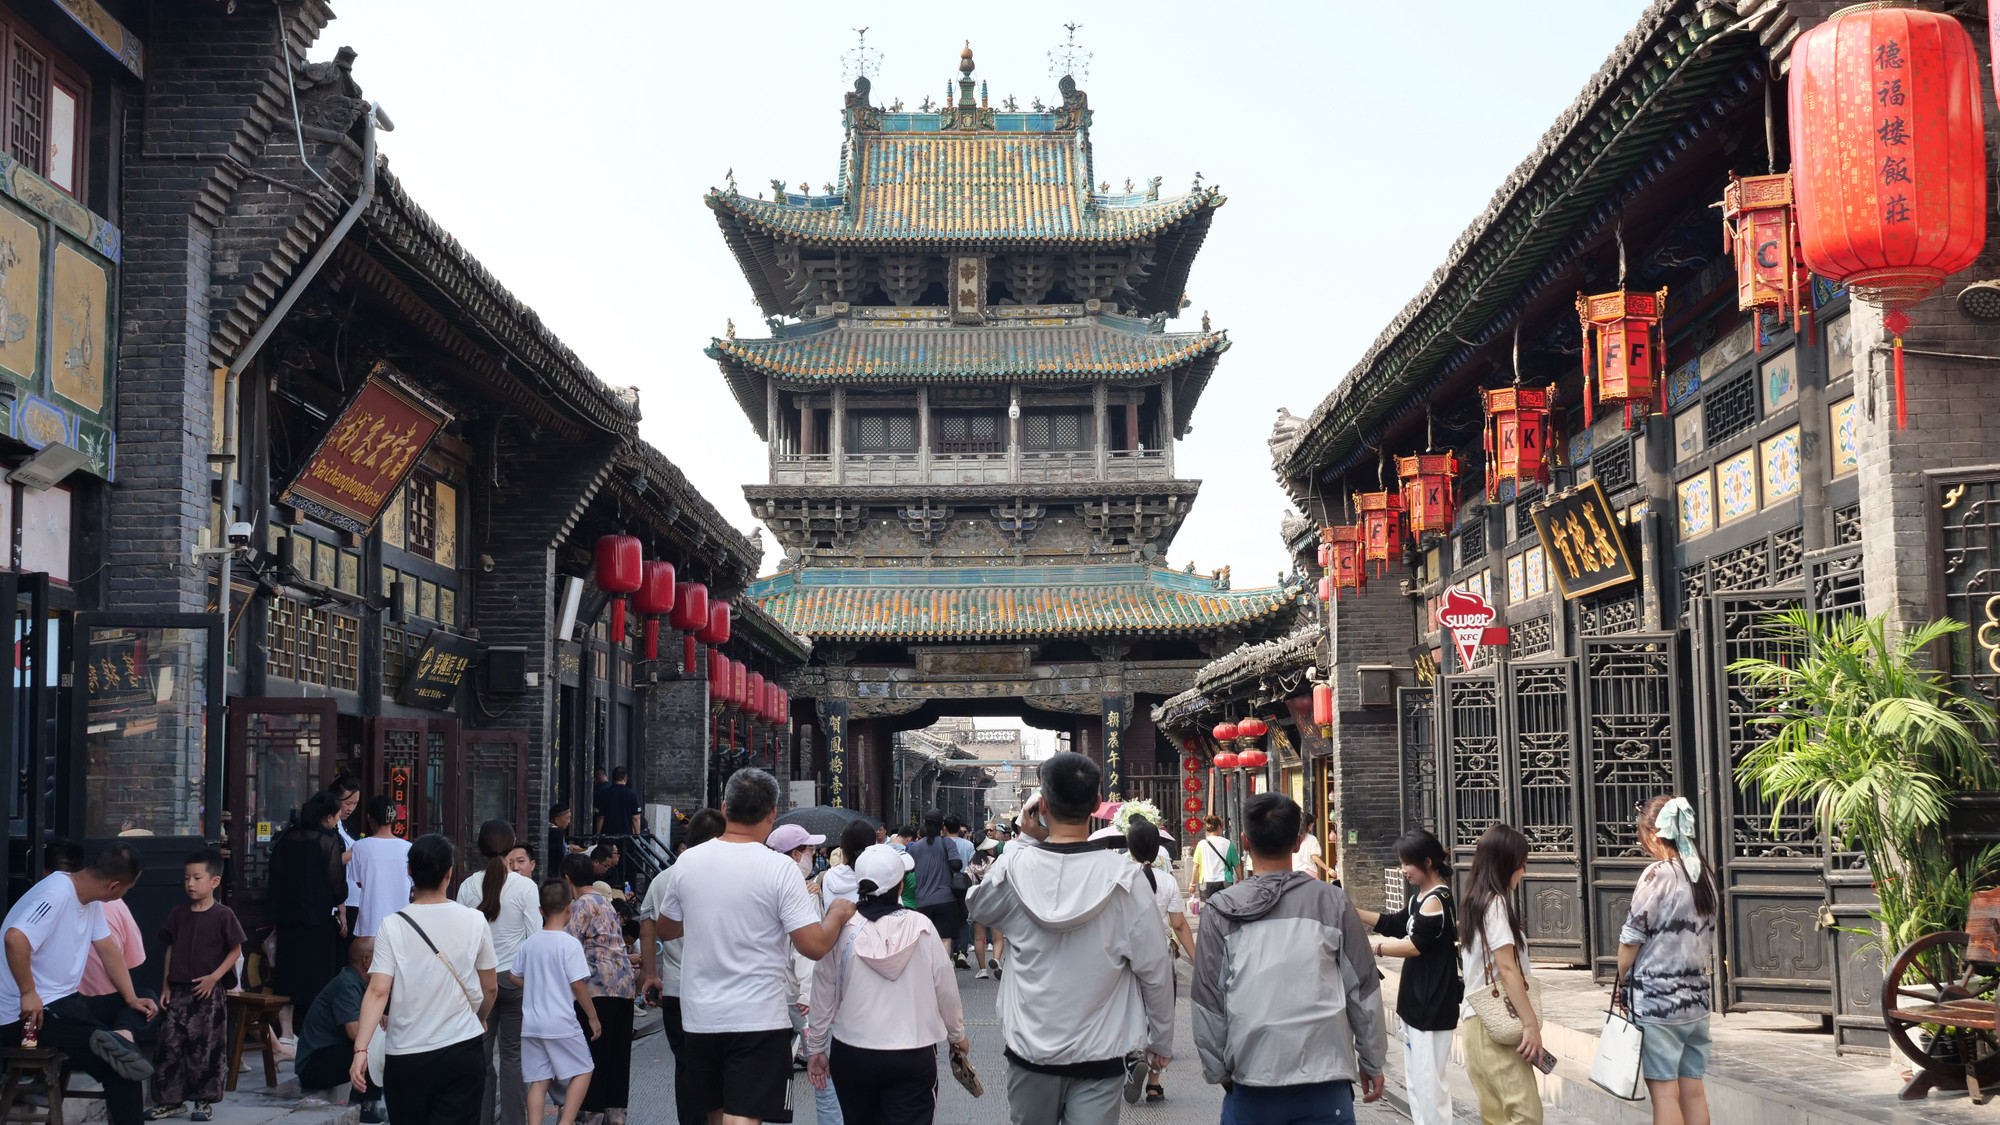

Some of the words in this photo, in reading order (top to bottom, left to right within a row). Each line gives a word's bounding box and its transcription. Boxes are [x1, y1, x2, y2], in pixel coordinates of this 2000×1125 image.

[1757, 240, 1779, 269] C
[1606, 343, 1621, 368] F
[1630, 343, 1645, 366] F
[1504, 428, 1514, 450] K
[1524, 428, 1536, 449] K
[1429, 487, 1439, 506] K
[1372, 523, 1382, 539] F
[1388, 523, 1397, 538] F
[1550, 500, 1618, 579] 肯德基
[1341, 556, 1352, 570] C
[1446, 613, 1490, 628] sweet
[1459, 633, 1479, 641] KFC
[393, 774, 406, 835] 今日房
